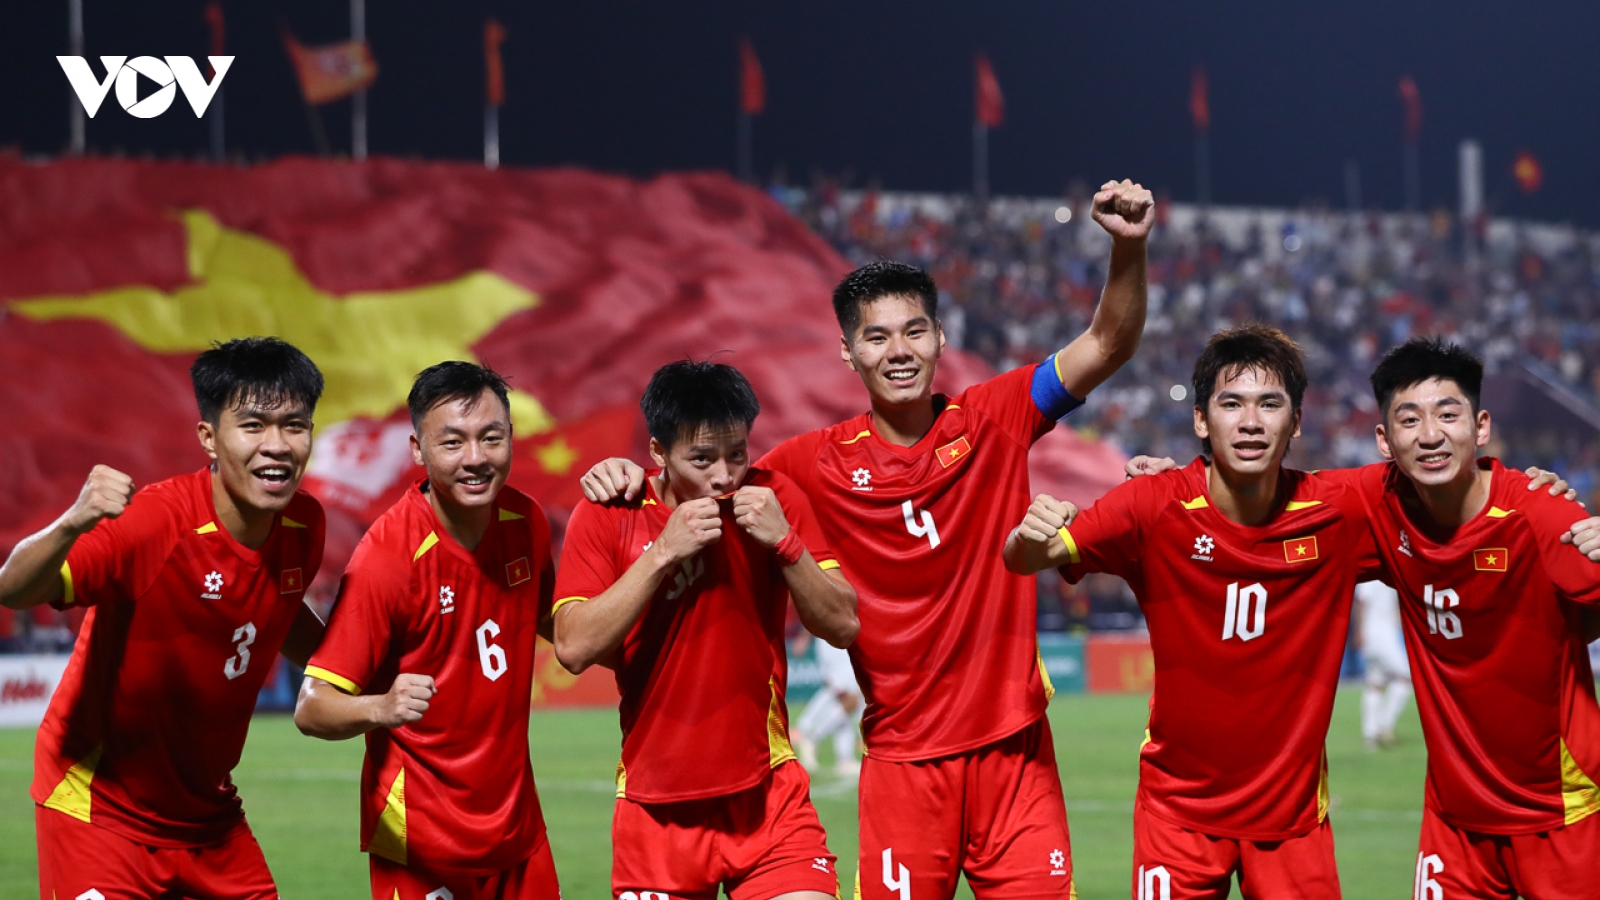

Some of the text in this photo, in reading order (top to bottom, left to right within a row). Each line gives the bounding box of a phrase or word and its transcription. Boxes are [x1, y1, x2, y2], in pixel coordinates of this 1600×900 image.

[901, 499, 941, 550] 4
[1222, 581, 1268, 642] 10
[1423, 584, 1464, 640] 16
[223, 621, 257, 681] 3
[475, 618, 508, 683] 6
[881, 847, 911, 900] 4
